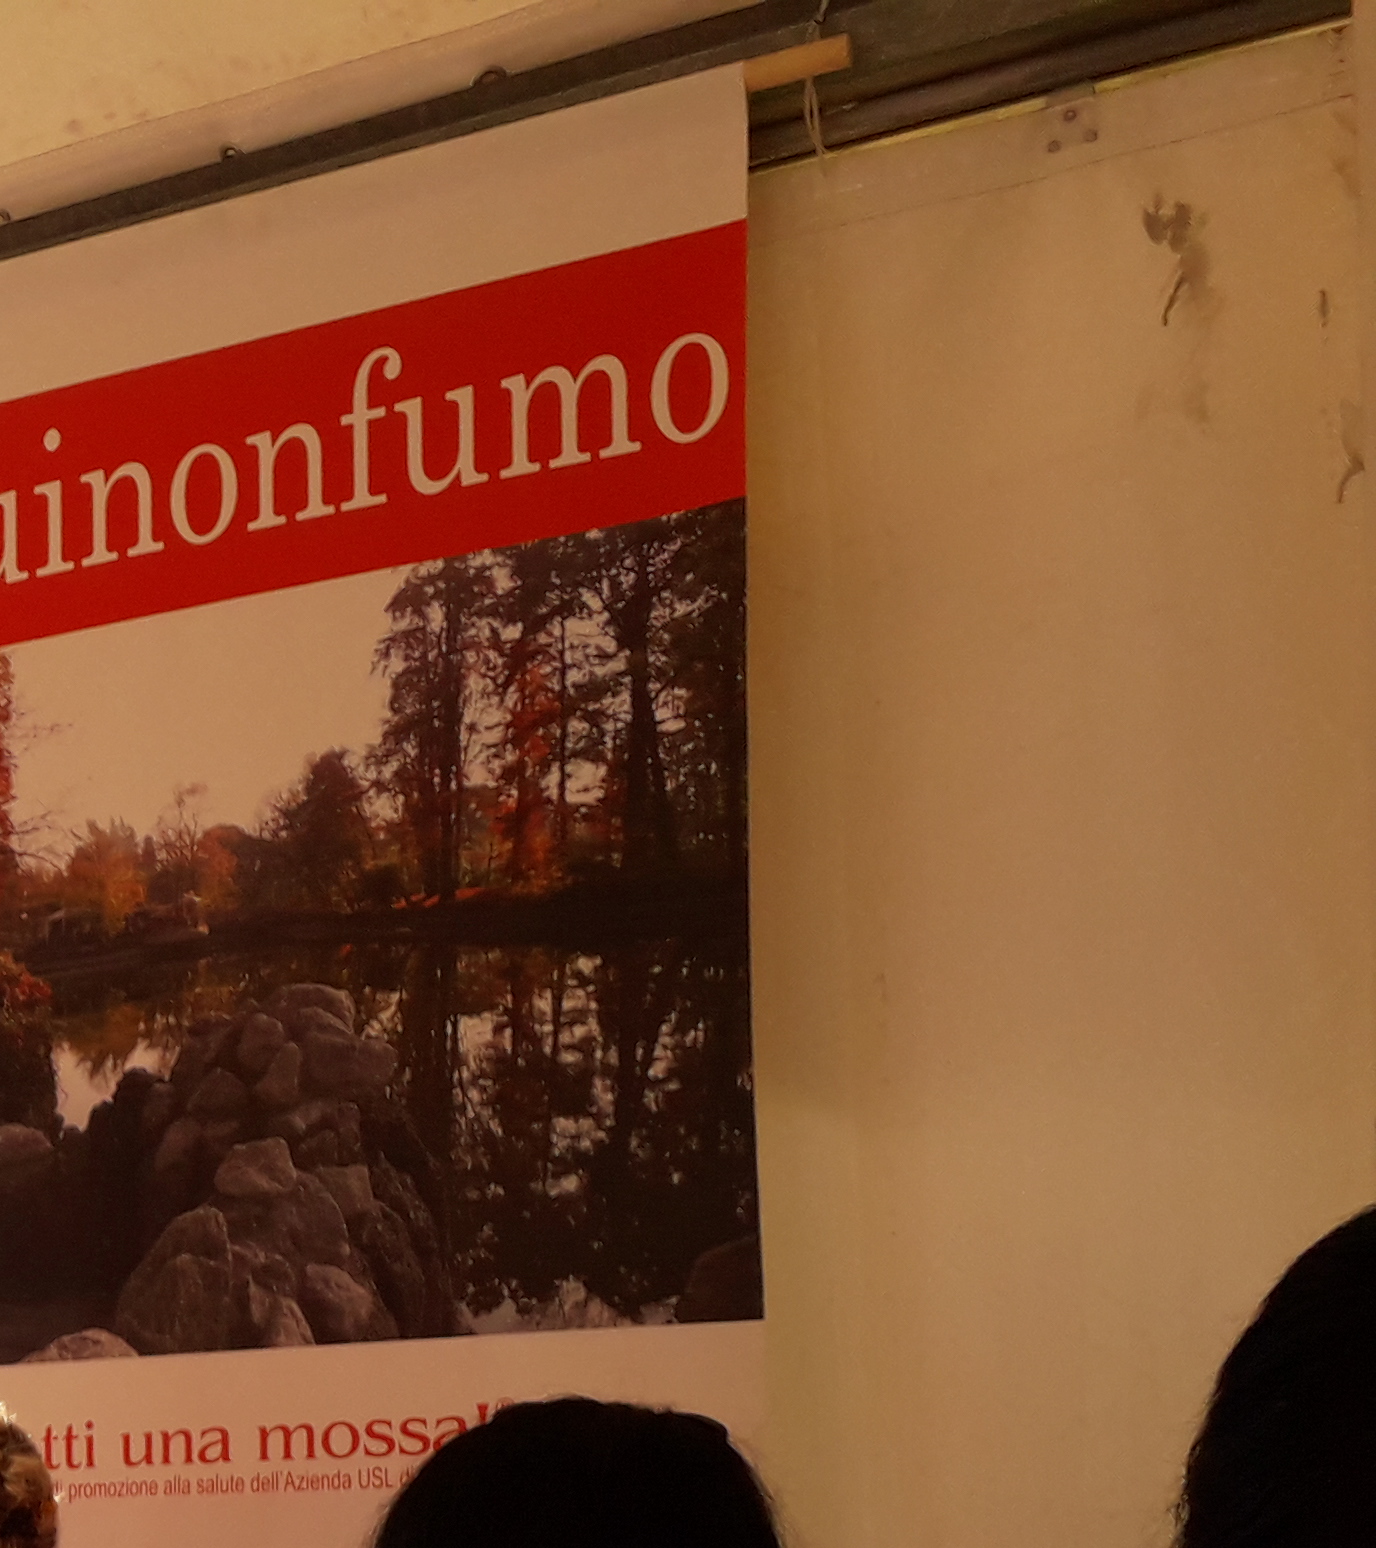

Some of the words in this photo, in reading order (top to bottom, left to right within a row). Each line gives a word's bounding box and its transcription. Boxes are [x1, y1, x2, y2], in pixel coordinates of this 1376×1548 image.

[42, 1419, 96, 1471] tti
[120, 1427, 231, 1468] una
[69, 1479, 159, 1503] promozione
[164, 1475, 191, 1496] alla
[196, 1474, 246, 1495] salute
[250, 1466, 352, 1494] dell'Azienda
[357, 1465, 394, 1492] USL
